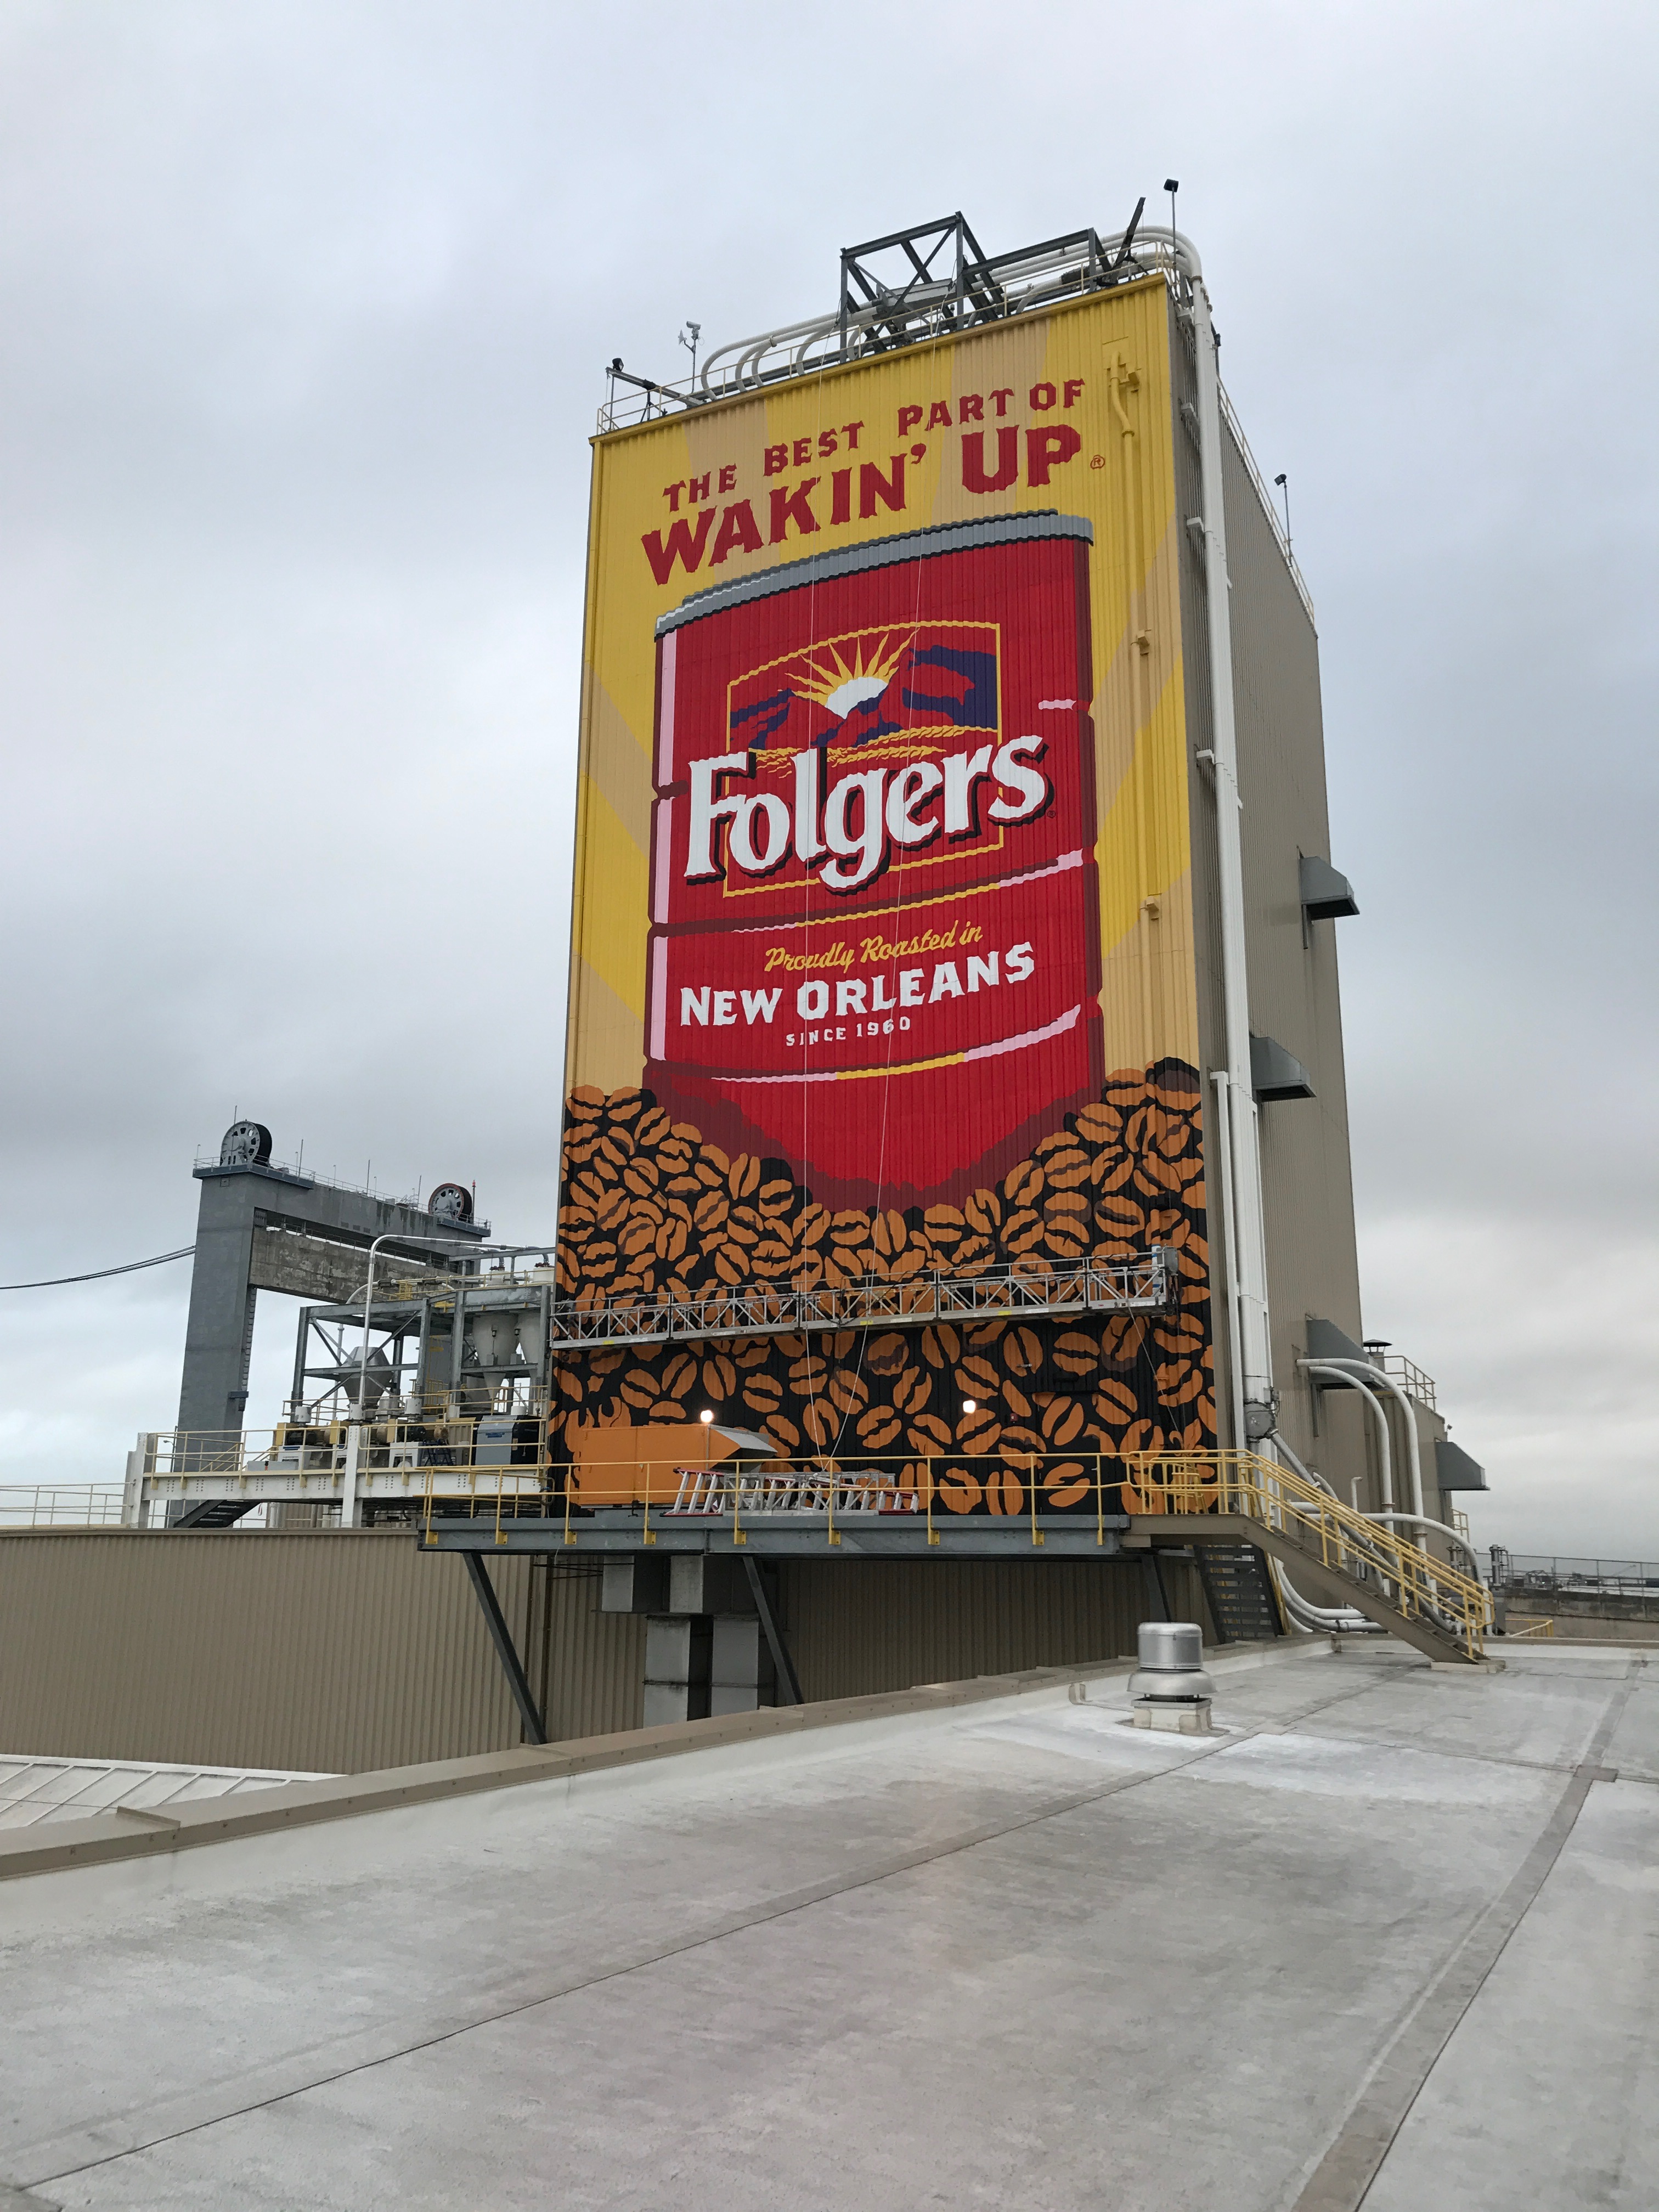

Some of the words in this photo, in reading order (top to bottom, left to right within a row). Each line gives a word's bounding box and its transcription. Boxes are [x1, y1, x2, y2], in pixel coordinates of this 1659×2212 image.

[663, 465, 737, 512] THE
[764, 421, 864, 477] BEST
[898, 388, 1014, 437] PART
[1029, 379, 1085, 411] OF
[641, 443, 927, 585] WAKIN'
[962, 425, 1081, 494] UP
[684, 735, 1048, 890] Folgers
[680, 986, 783, 1026] NEW
[797, 941, 1035, 1020] ORLEANS
[765, 941, 855, 973] Proudly
[860, 919, 957, 963] Roasted
[959, 921, 983, 945] in
[786, 1028, 846, 1046] SINCE
[856, 1016, 911, 1037] 1960
